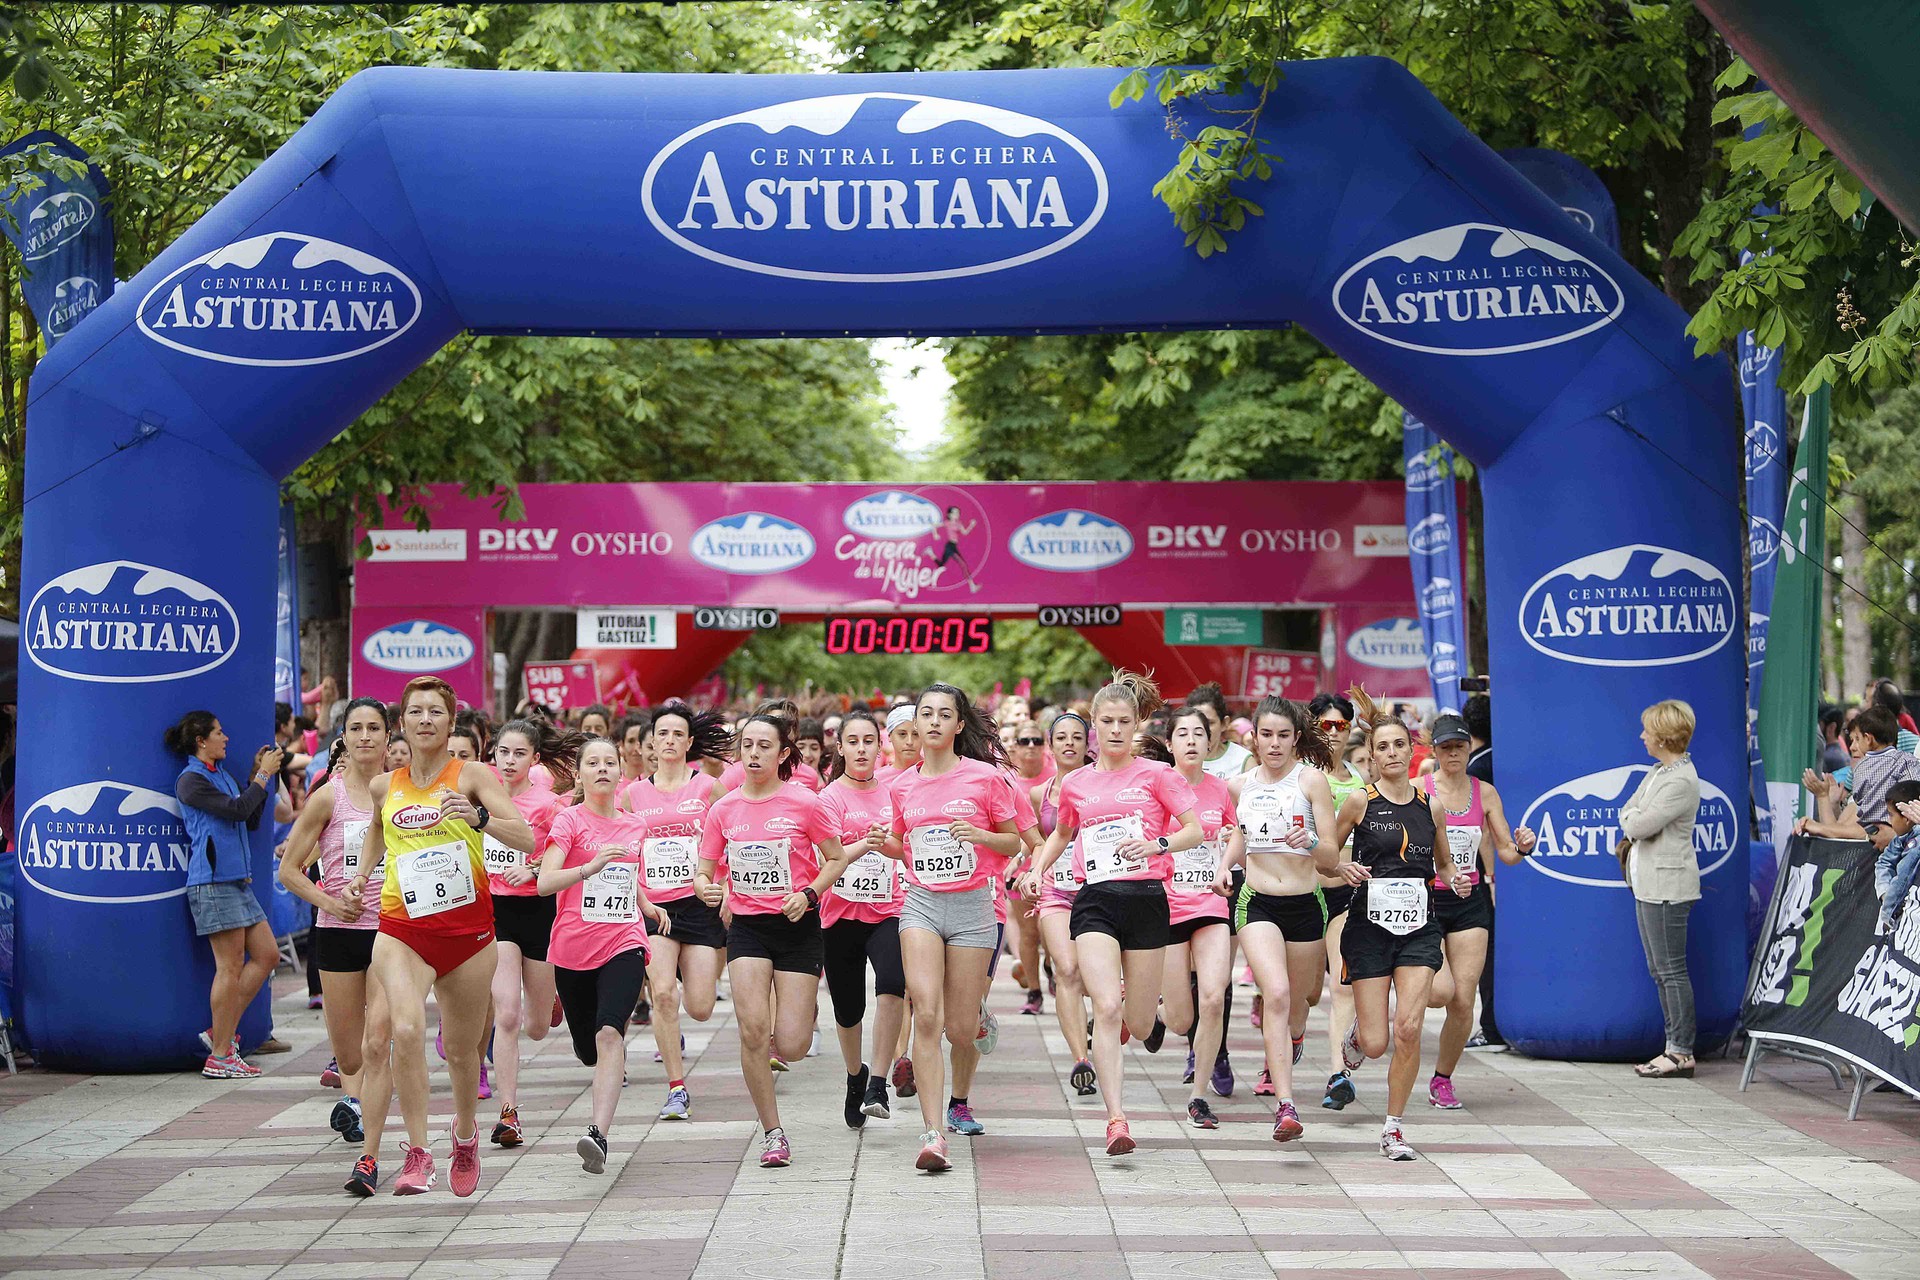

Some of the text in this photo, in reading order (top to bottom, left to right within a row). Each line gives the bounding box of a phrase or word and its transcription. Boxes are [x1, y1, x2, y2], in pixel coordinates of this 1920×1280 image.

[750, 146, 1057, 166] CENTRAL LECHERA
[677, 151, 1074, 231] ASTURIANA
[1396, 264, 1591, 286] CENTRAL LECHERA
[201, 277, 393, 294] CENTRAL LECHERA
[152, 284, 399, 333] ASTURIANA
[1357, 276, 1608, 325] ASTURIANA
[395, 528, 673, 557] Santander DKV OYSHO
[701, 534, 804, 556] ASTURIANA
[835, 534, 918, 561] Carrera
[1020, 534, 1123, 555] ASTURIANA
[1148, 525, 1341, 553] DKV OYSHO
[881, 557, 946, 599] Mujer
[1569, 585, 1723, 600] CENTRAL LECHERA
[58, 602, 218, 618] CENTRAL LECHERA
[695, 609, 778, 628] OYSHO
[1039, 606, 1120, 626] OYSHO
[1533, 592, 1728, 639] ASTURIANA
[32, 605, 224, 654] ASTURIANA
[597, 615, 647, 628] VITORIA
[598, 631, 646, 643] GASTEIZ
[827, 618, 989, 654] 00:00:05
[372, 641, 465, 658] ASTURIANA
[1255, 655, 1291, 673] SUB
[528, 667, 564, 685] SUB
[397, 812, 439, 825] Serrano
[1370, 821, 1401, 832] Physio
[47, 822, 183, 836] CENTRAL LECHE
[1260, 822, 1268, 835] 4
[24, 823, 190, 872] ASTURIAN
[485, 848, 515, 863] 3666
[1407, 843, 1431, 855] Sport
[415, 857, 449, 870] ASTURIANA
[658, 865, 690, 878] 5785
[927, 855, 963, 872] 5287
[742, 870, 779, 884] 4728
[852, 877, 879, 891] 425
[1186, 870, 1214, 883] 2789
[435, 883, 446, 898] 8
[432, 900, 449, 908] DKV
[603, 896, 629, 910] 478
[1384, 909, 1418, 922] 2762
